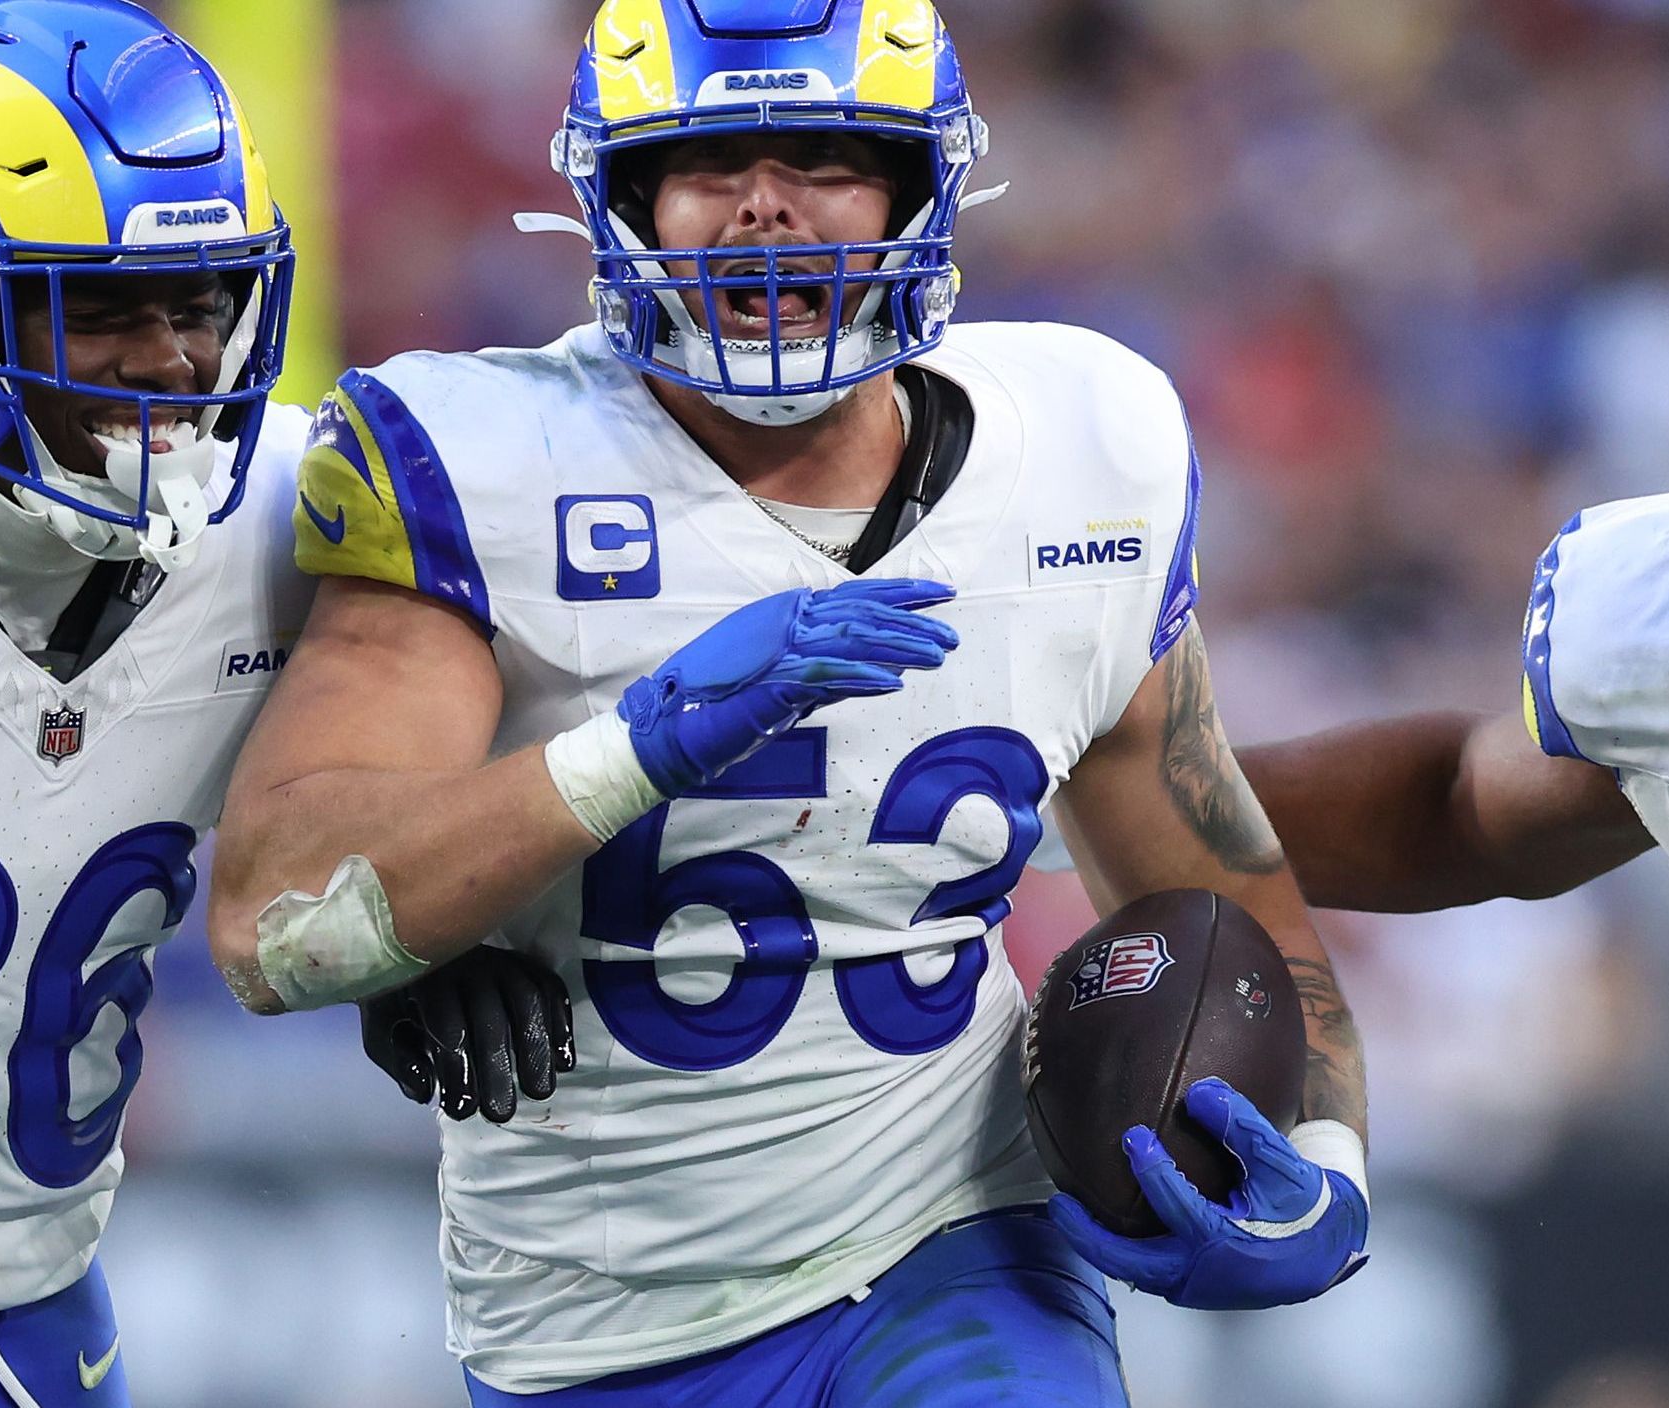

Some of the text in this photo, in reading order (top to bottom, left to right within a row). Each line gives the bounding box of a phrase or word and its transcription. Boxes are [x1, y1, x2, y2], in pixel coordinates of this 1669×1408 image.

[725, 72, 809, 91] RAMS
[155, 206, 230, 227] RAMS
[565, 500, 652, 574] C
[1036, 536, 1143, 570] RAMS
[226, 648, 289, 678] RAM
[45, 730, 77, 755] NFL
[581, 725, 1050, 1071] 53
[1104, 938, 1160, 990] NFL
